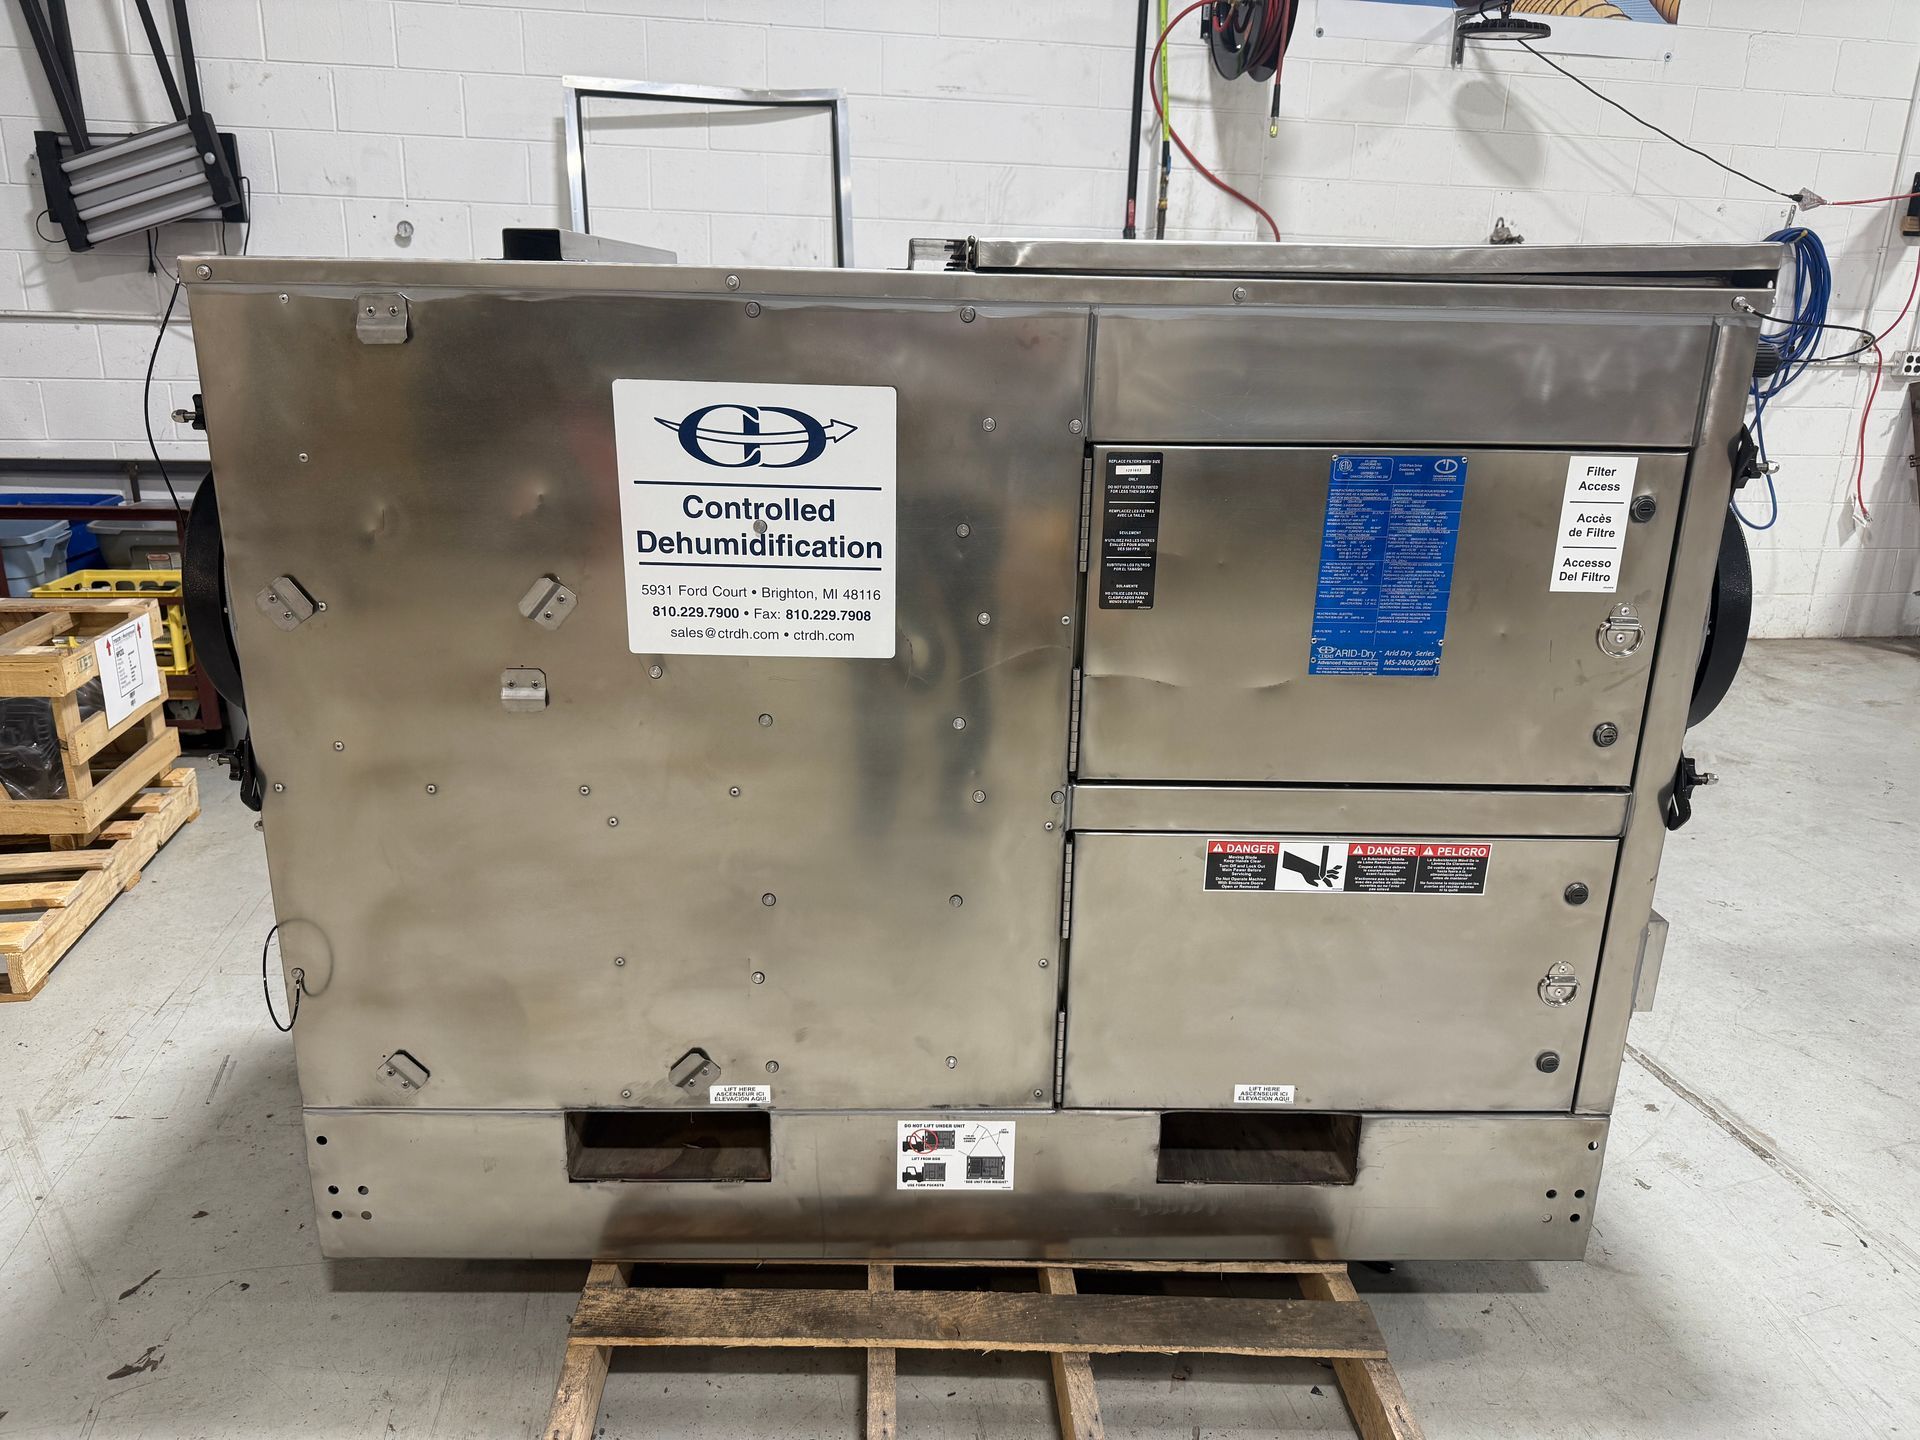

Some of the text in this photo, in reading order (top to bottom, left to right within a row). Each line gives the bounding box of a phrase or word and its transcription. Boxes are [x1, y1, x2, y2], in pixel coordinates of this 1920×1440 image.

[1587, 467, 1616, 476] Filter
[1579, 481, 1620, 491] Access
[682, 494, 835, 522] Controlled
[1577, 514, 1612, 523] Accès
[1569, 528, 1615, 537] de Filtre
[637, 530, 882, 559] Dehumidification
[1563, 558, 1611, 567] Accesso
[1559, 572, 1610, 582] Del Filtro
[641, 585, 881, 600] 5931 Ford Court Brighton, MI 48116
[652, 606, 871, 621] 810.229.7900 Fax: 810.229.7908
[671, 628, 854, 642] sales@ctrdh.com ctrdh.com
[1227, 844, 1274, 853] DANGER
[1367, 846, 1416, 855] DANGER
[1438, 848, 1486, 856] PELIGRO
